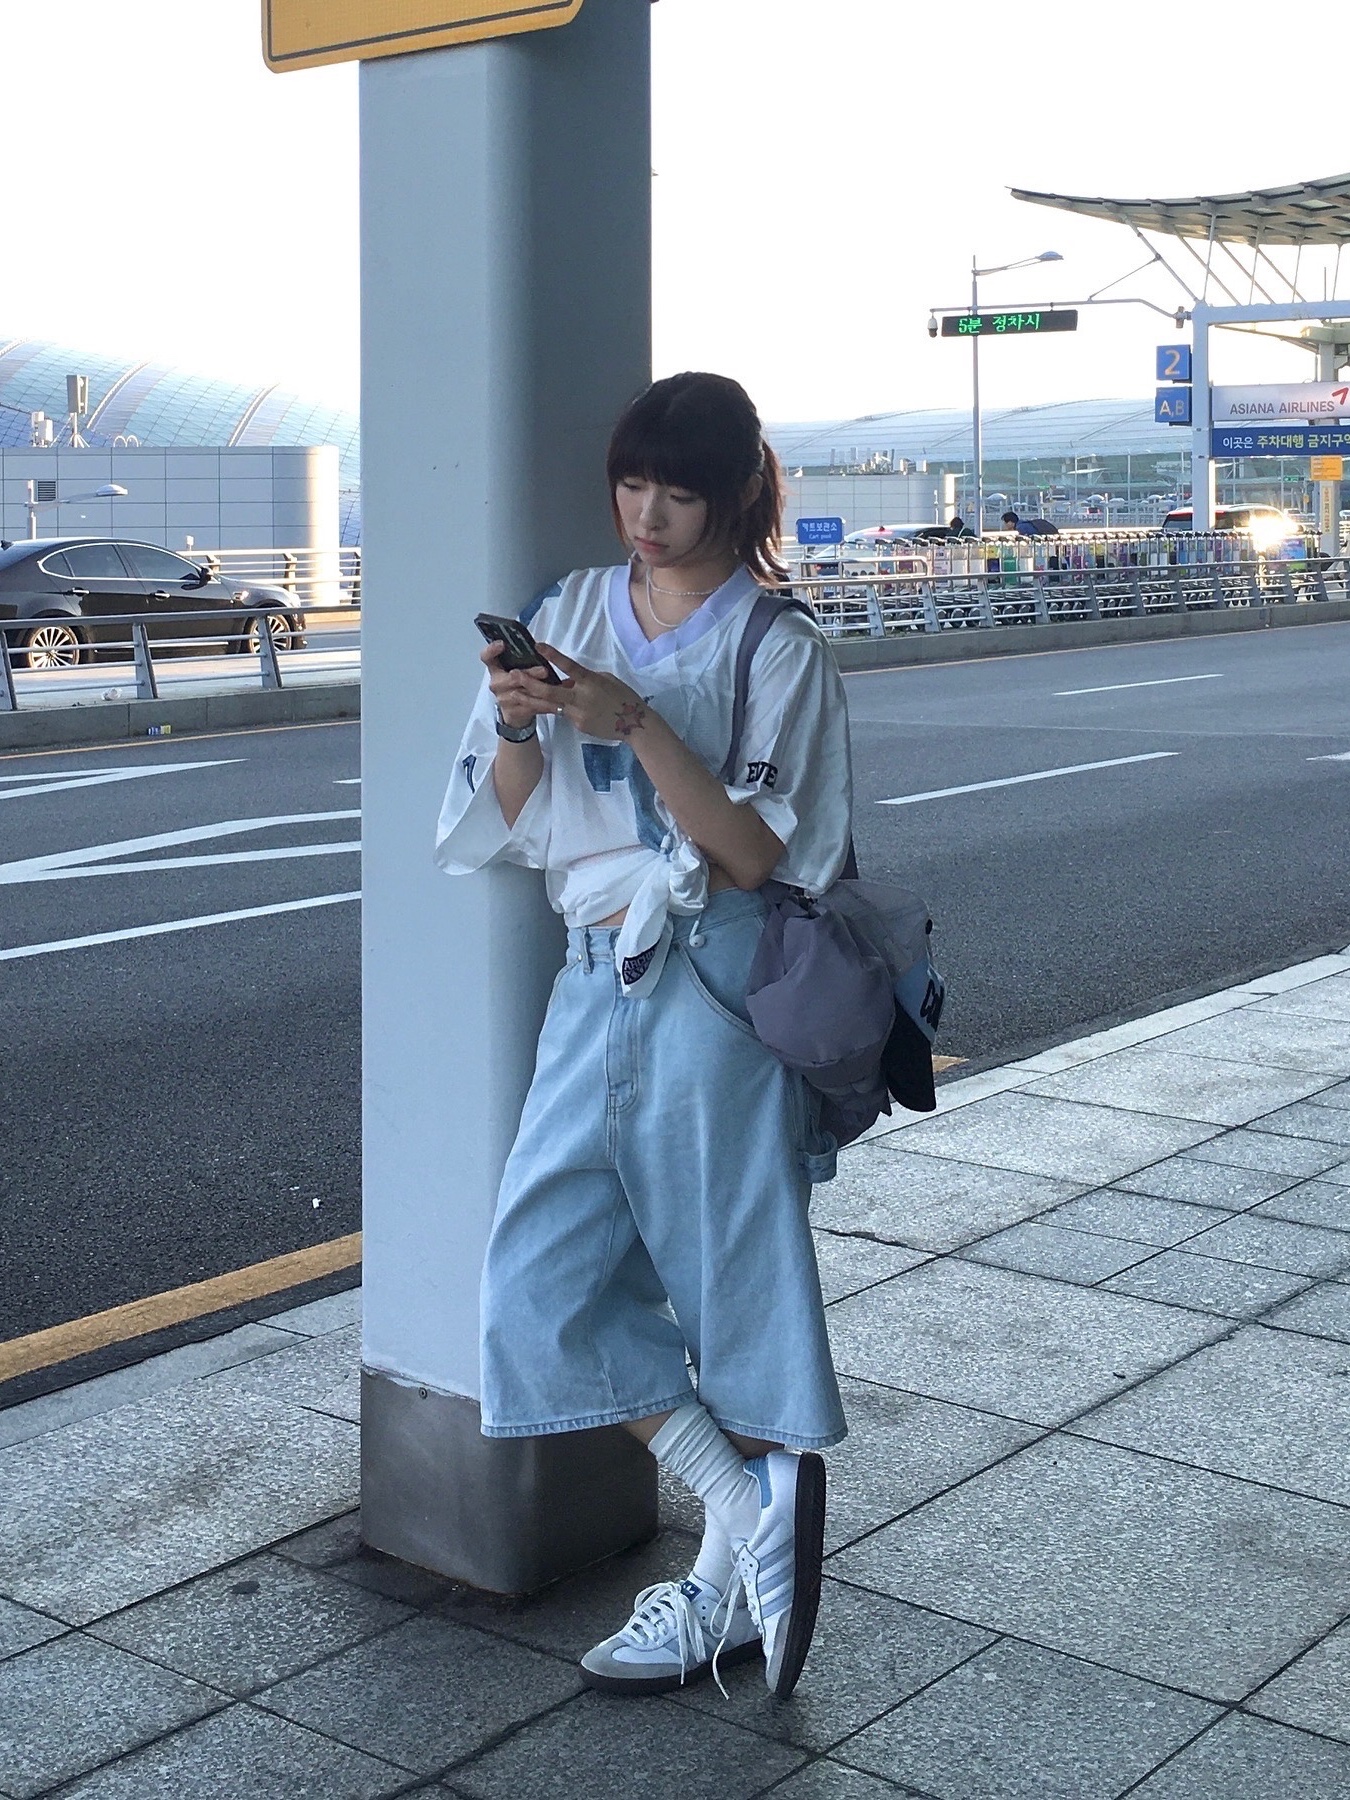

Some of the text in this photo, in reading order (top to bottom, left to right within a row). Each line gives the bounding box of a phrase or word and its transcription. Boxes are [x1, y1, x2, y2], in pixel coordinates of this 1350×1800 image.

[958, 313, 1040, 334] 5분 정차시
[1164, 349, 1181, 376] 2
[1229, 400, 1336, 415] ASIANA AIRLINES
[1222, 436, 1254, 450] 이곳은
[1256, 433, 1305, 449] 주차대행
